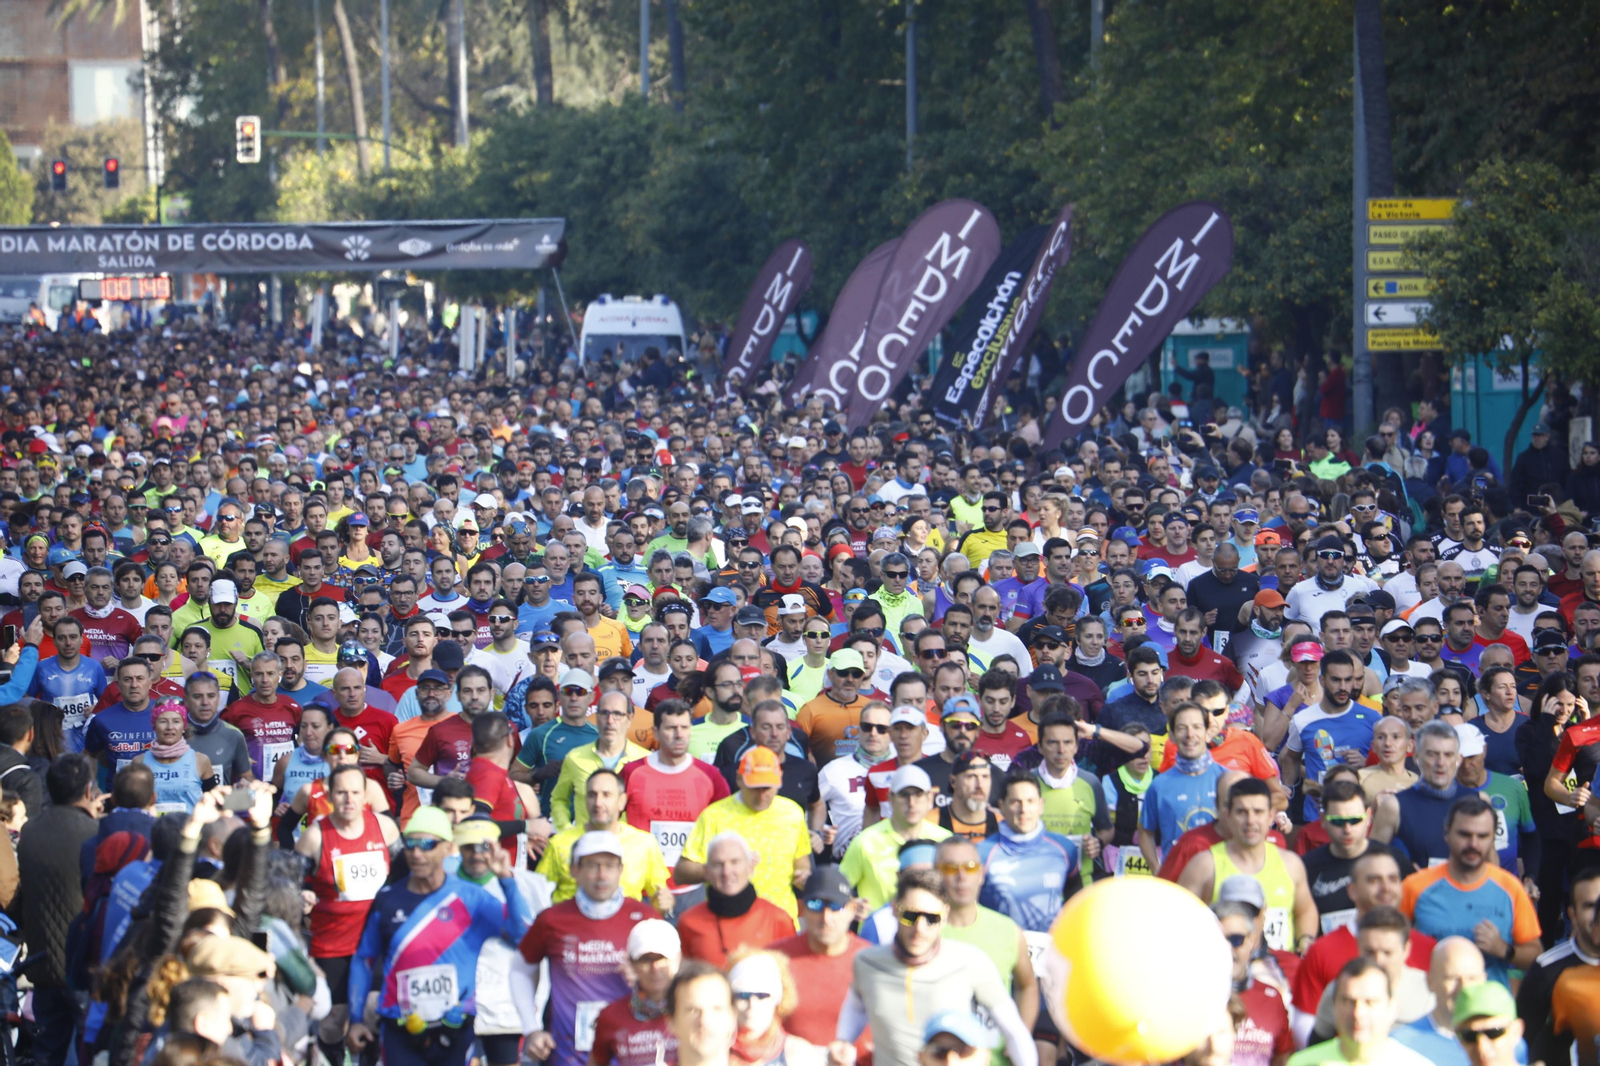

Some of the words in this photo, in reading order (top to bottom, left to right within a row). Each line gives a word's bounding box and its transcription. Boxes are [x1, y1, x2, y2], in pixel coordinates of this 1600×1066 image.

[1371, 211, 1382, 219] La
[1386, 211, 1420, 219] Victoria
[1373, 231, 1398, 239] PASEO
[47, 231, 160, 252] MARATÓN
[168, 232, 195, 251] DE
[202, 229, 314, 251] CÓRDOBA
[98, 254, 156, 269] SALIDA
[944, 270, 1023, 405] Especolchón
[1371, 340, 1401, 348] Parking
[265, 721, 287, 729] MEDIA
[253, 728, 265, 737] 36
[123, 742, 140, 751] Bull
[456, 751, 469, 761] 36
[154, 769, 179, 781] erja
[290, 770, 325, 780] nerja
[350, 864, 377, 880] 996
[578, 940, 615, 952] MEDIA
[411, 977, 452, 997] 5400
